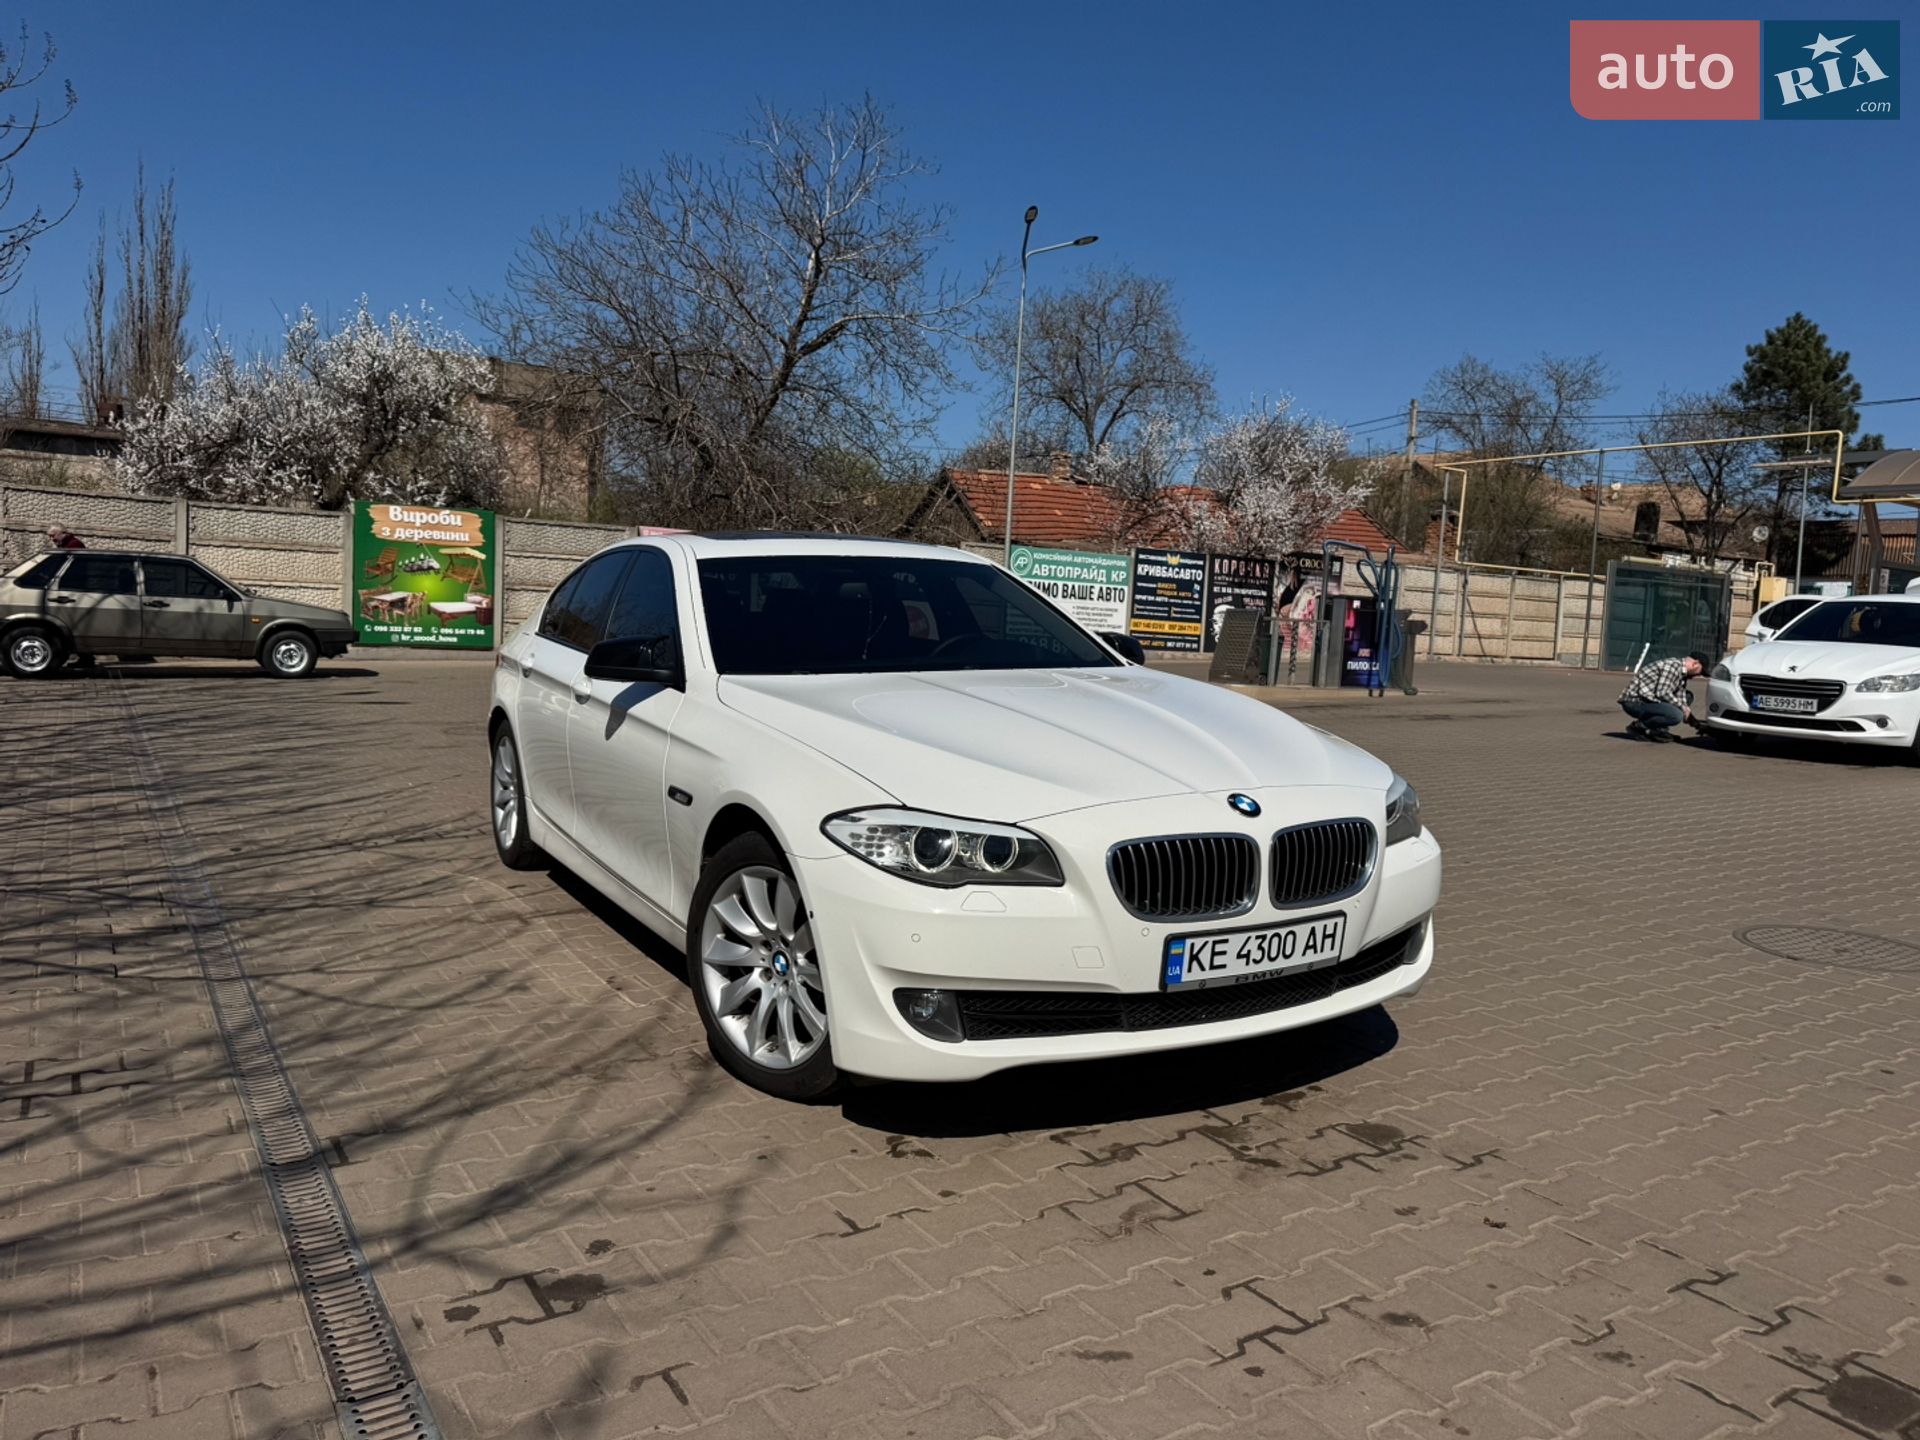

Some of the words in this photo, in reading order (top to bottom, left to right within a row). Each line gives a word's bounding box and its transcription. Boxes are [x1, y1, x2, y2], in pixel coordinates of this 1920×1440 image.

[389, 505, 462, 526] Вироби
[381, 527, 391, 536] з
[394, 527, 470, 542] деревини
[1032, 563, 1107, 583] АВТОПРАЙД
[1111, 570, 1127, 582] КР
[1137, 563, 1203, 581] КРИВБАСАВТО
[1061, 583, 1095, 601] ВАШЕ
[1096, 587, 1126, 603] АВТО
[1759, 696, 1772, 706] AE
[1773, 697, 1797, 709] 5995
[1798, 699, 1814, 710] HM
[1187, 938, 1229, 973] KE
[1236, 930, 1297, 966] 4300
[1301, 921, 1338, 957] AH
[1167, 966, 1181, 976] UA
